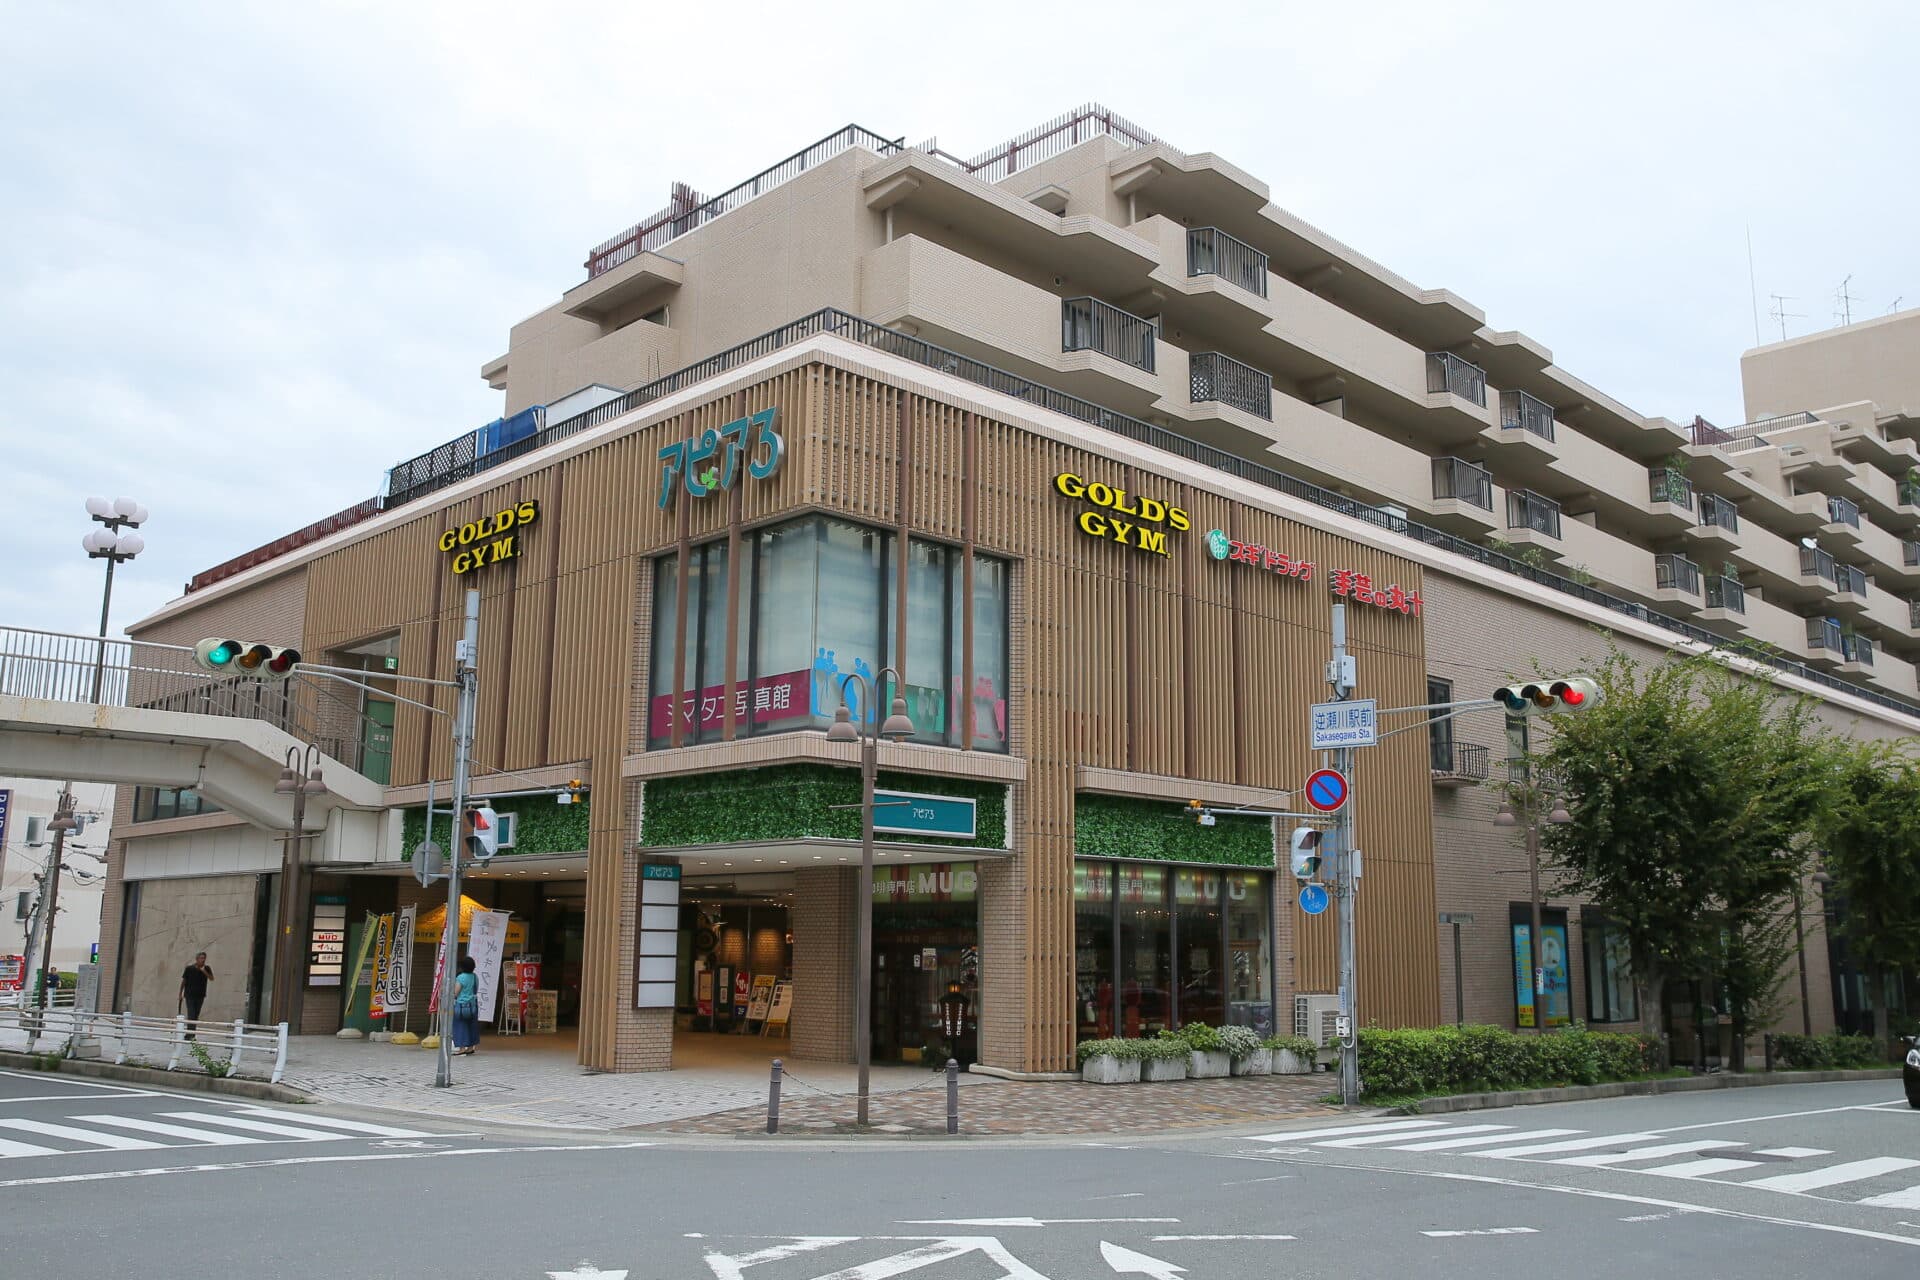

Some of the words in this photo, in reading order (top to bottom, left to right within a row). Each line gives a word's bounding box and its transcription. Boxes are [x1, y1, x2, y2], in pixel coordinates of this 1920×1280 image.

[1056, 472, 1190, 531] GOLD'S
[438, 501, 536, 552] GOLD'S
[1229, 540, 1316, 581] スギドラッグ
[1334, 568, 1424, 617] 手芸の丸十
[1315, 708, 1371, 730] 逆瀬川駅前
[1316, 731, 1357, 742] Sakasegawa
